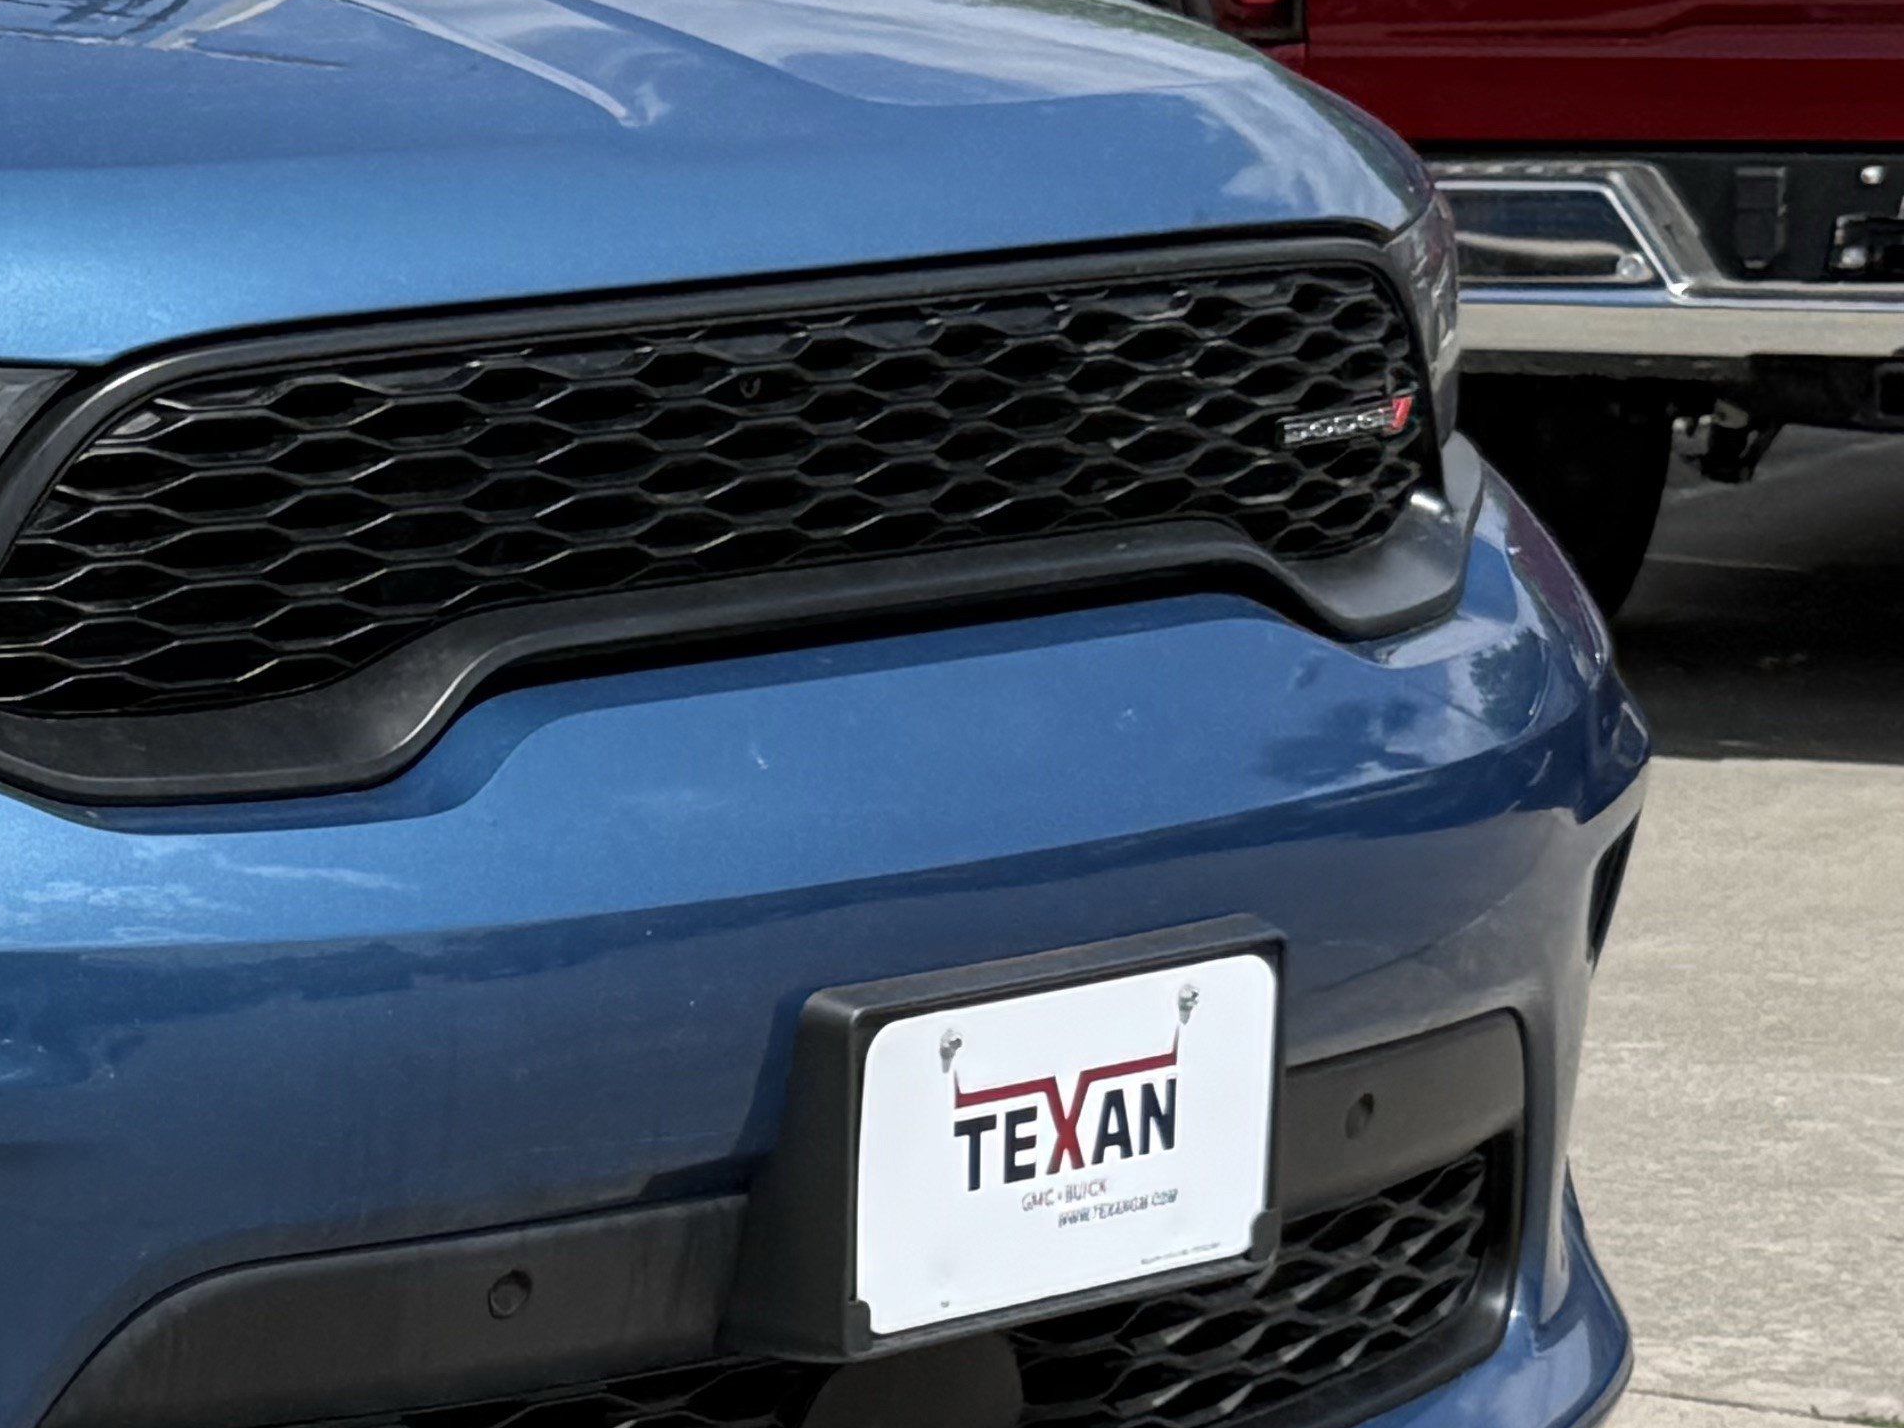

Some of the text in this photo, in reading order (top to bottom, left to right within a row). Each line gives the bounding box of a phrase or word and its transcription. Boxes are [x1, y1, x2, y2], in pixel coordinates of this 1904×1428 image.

[953, 1058, 1178, 1192] TEXAN
[1021, 1178, 1108, 1212] GMC BUICK
